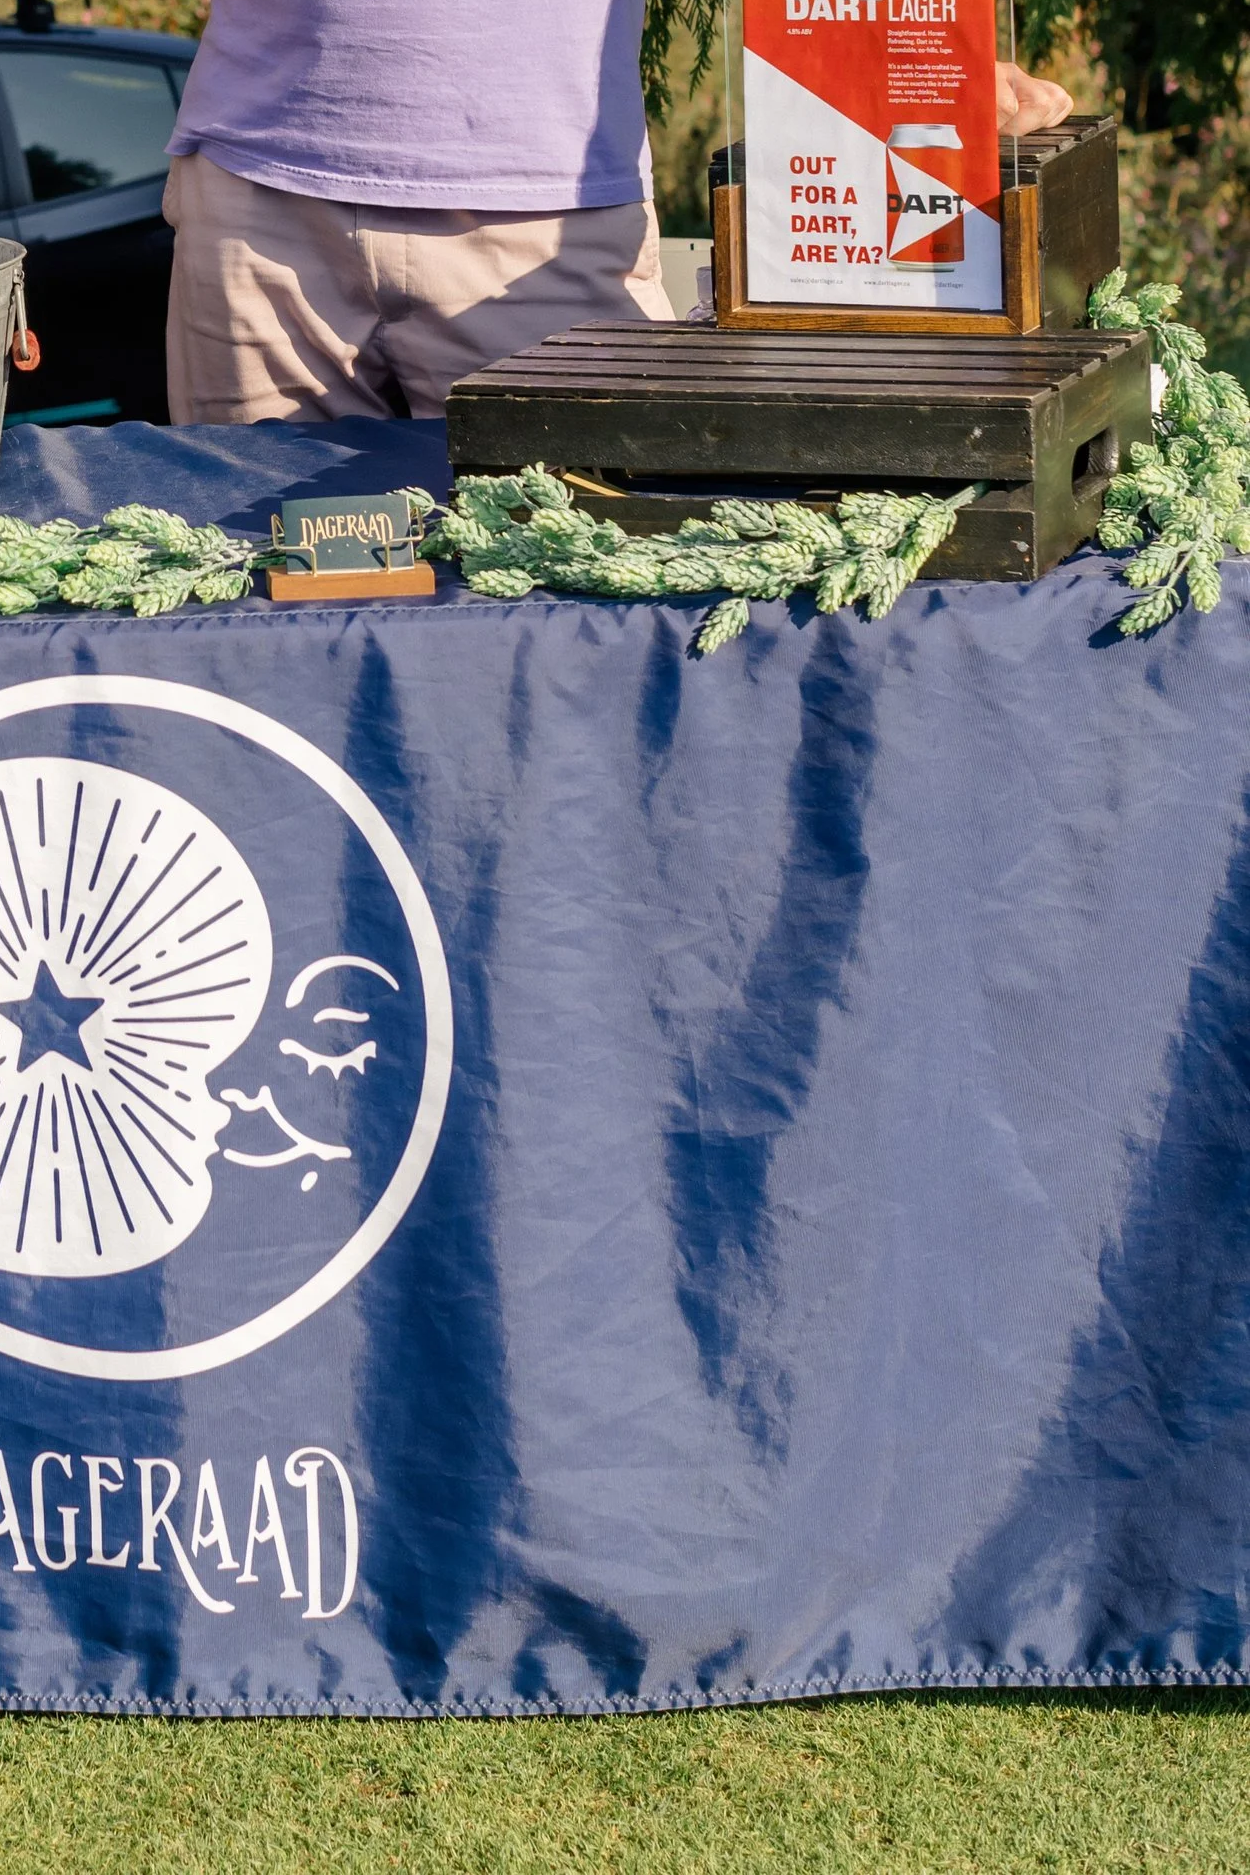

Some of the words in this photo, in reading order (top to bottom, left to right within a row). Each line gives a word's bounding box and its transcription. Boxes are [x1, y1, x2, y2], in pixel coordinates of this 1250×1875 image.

[789, 155, 837, 175] OUT
[790, 185, 837, 204] FOR
[842, 186, 858, 205] A
[887, 194, 964, 215] DART
[791, 214, 857, 240] DART,
[791, 243, 838, 263] ARE
[842, 245, 884, 265] YA?
[300, 512, 394, 548] DAGERAAD
